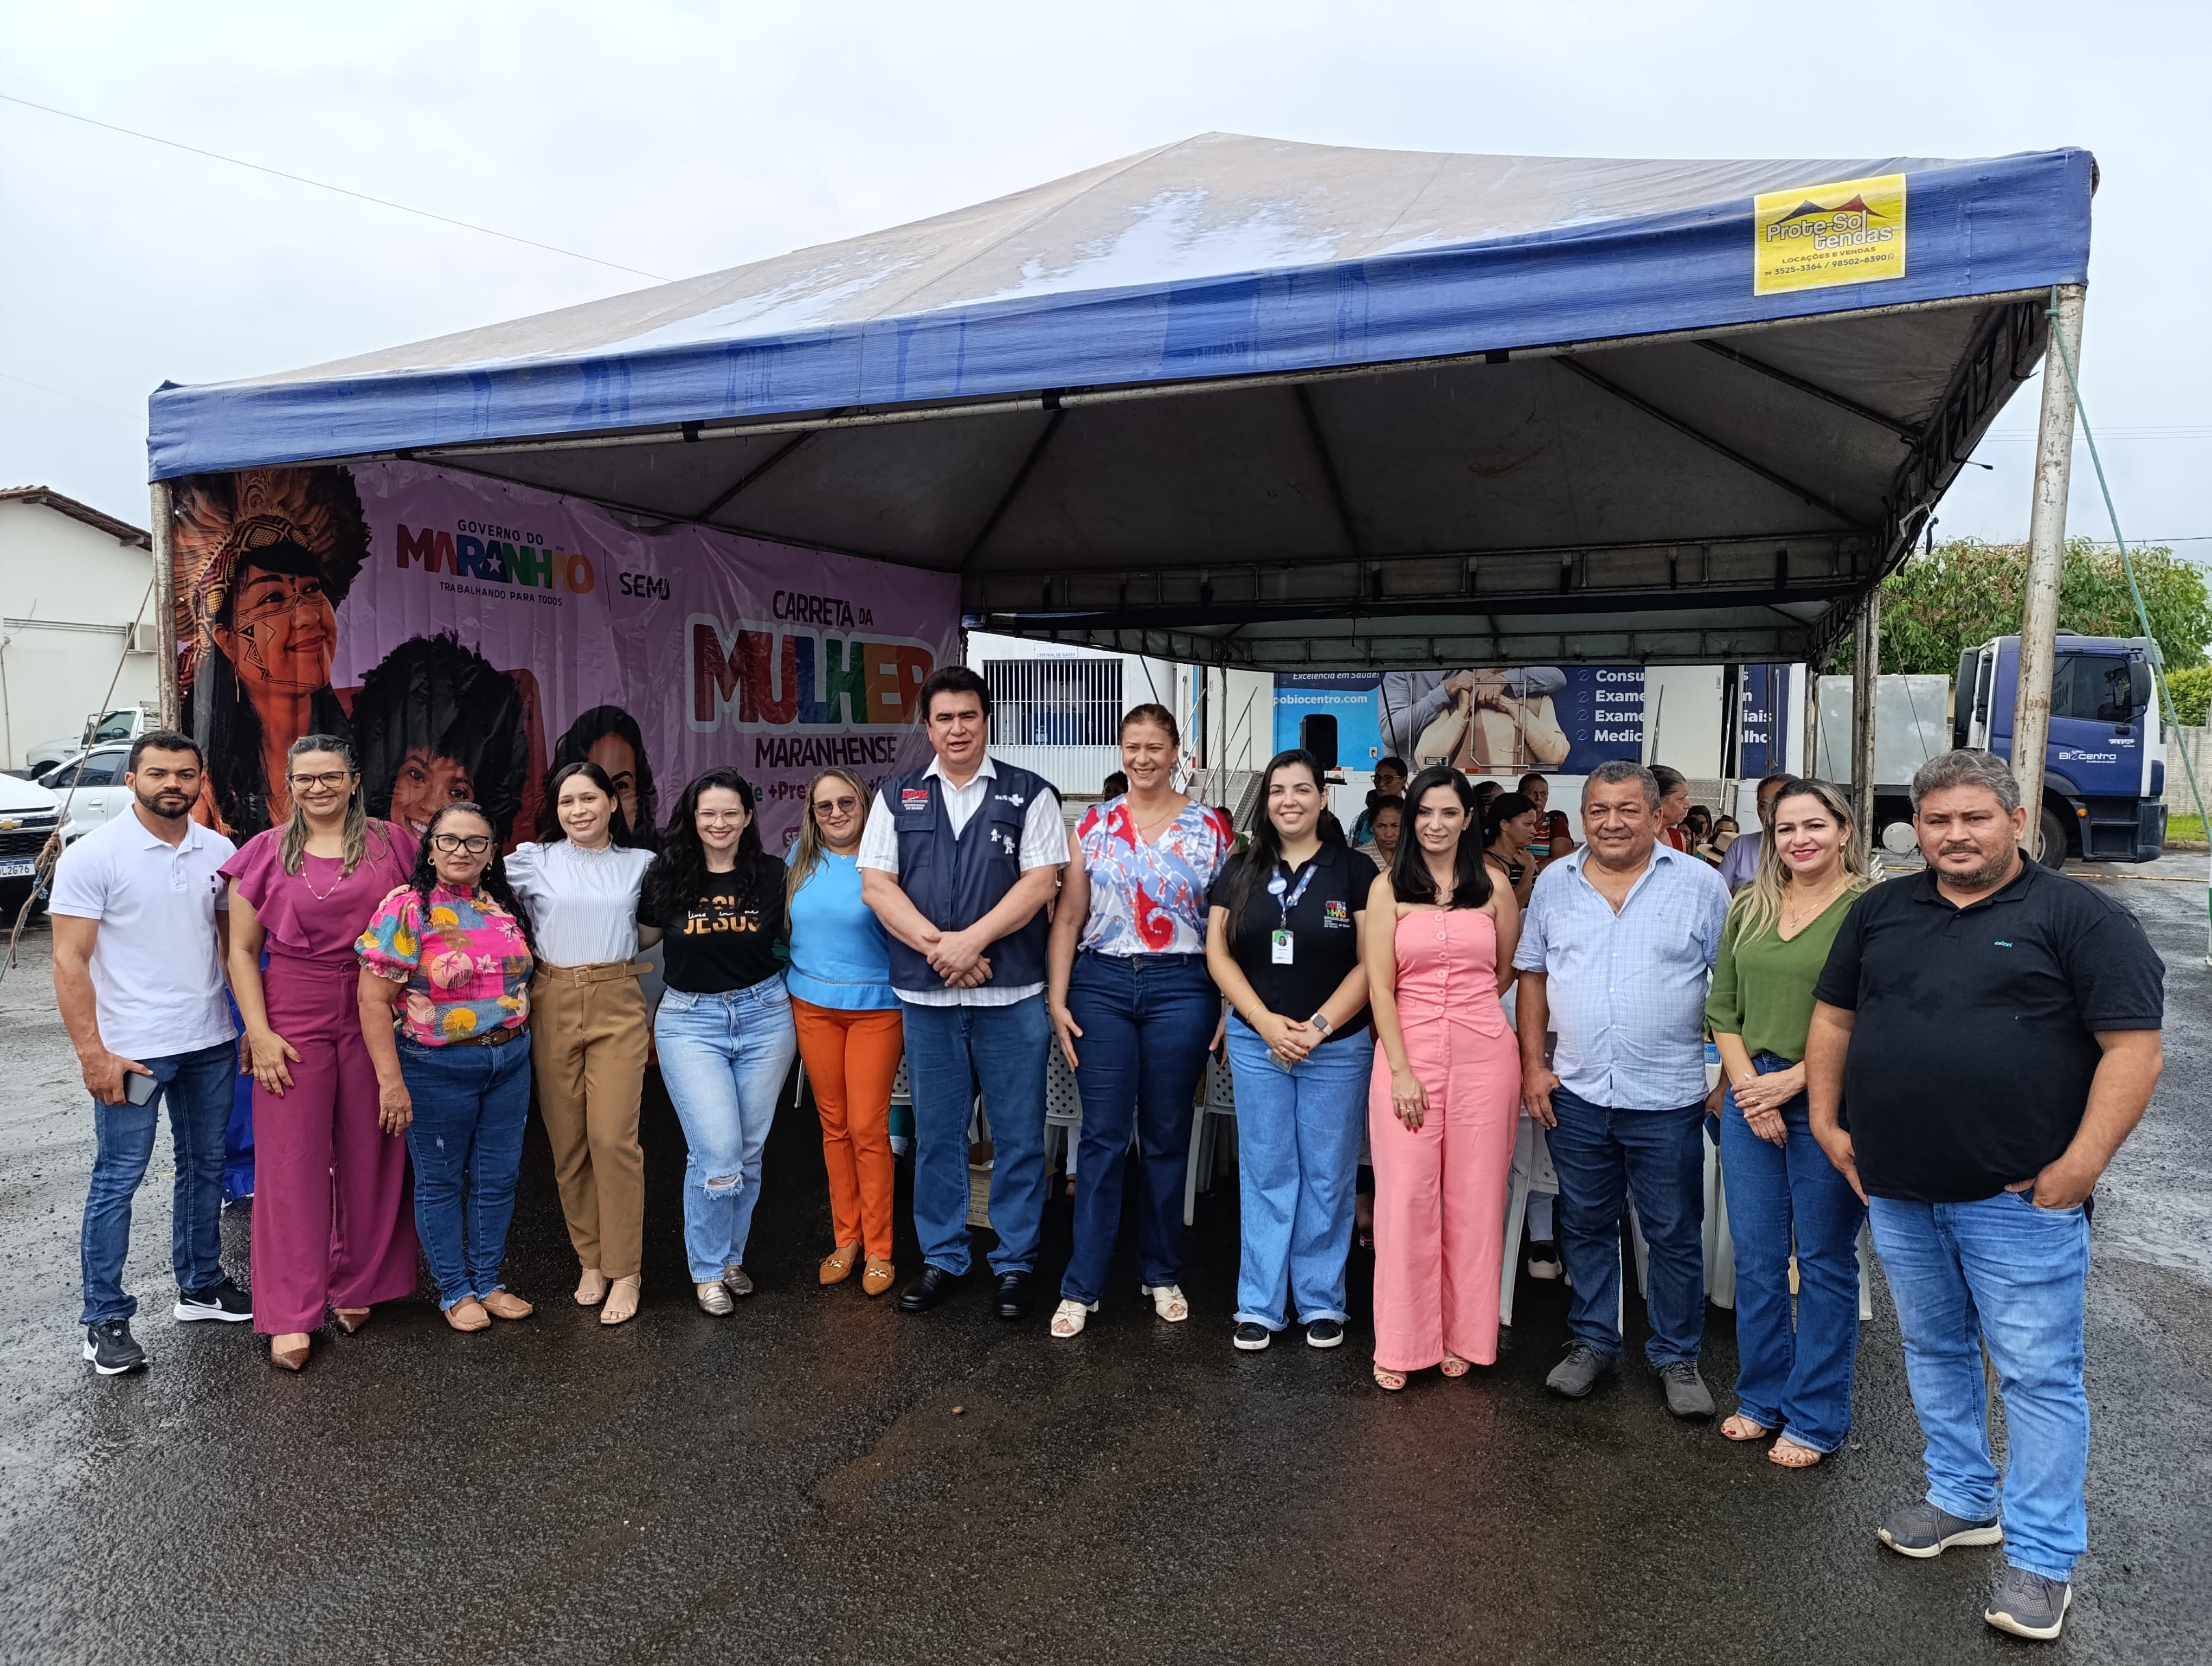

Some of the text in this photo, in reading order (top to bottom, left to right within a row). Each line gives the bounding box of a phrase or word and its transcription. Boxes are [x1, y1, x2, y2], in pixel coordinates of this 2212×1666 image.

[1766, 209, 1867, 242] Prote-Sol
[1814, 226, 1893, 251] tendas
[1774, 262, 1822, 275] 3525-3364
[1832, 254, 1887, 267] 98502-6390
[1782, 252, 1830, 264] LOCAÇÕES
[1840, 246, 1876, 257] VENDAS
[458, 519, 543, 546] GOVERNO DO
[439, 581, 563, 606] TRABALHANDO PARA TODOS
[619, 572, 670, 600] SEMU
[773, 589, 873, 628] CARRETA DA
[693, 623, 934, 725] MULHER
[1596, 670, 1644, 682] Consu
[1274, 695, 1368, 706] pobiocentro.com
[1596, 690, 1645, 702] Exame
[1595, 710, 1772, 722] Exame iais
[1594, 729, 1643, 742] Medic
[755, 736, 897, 768] MARANHENSE
